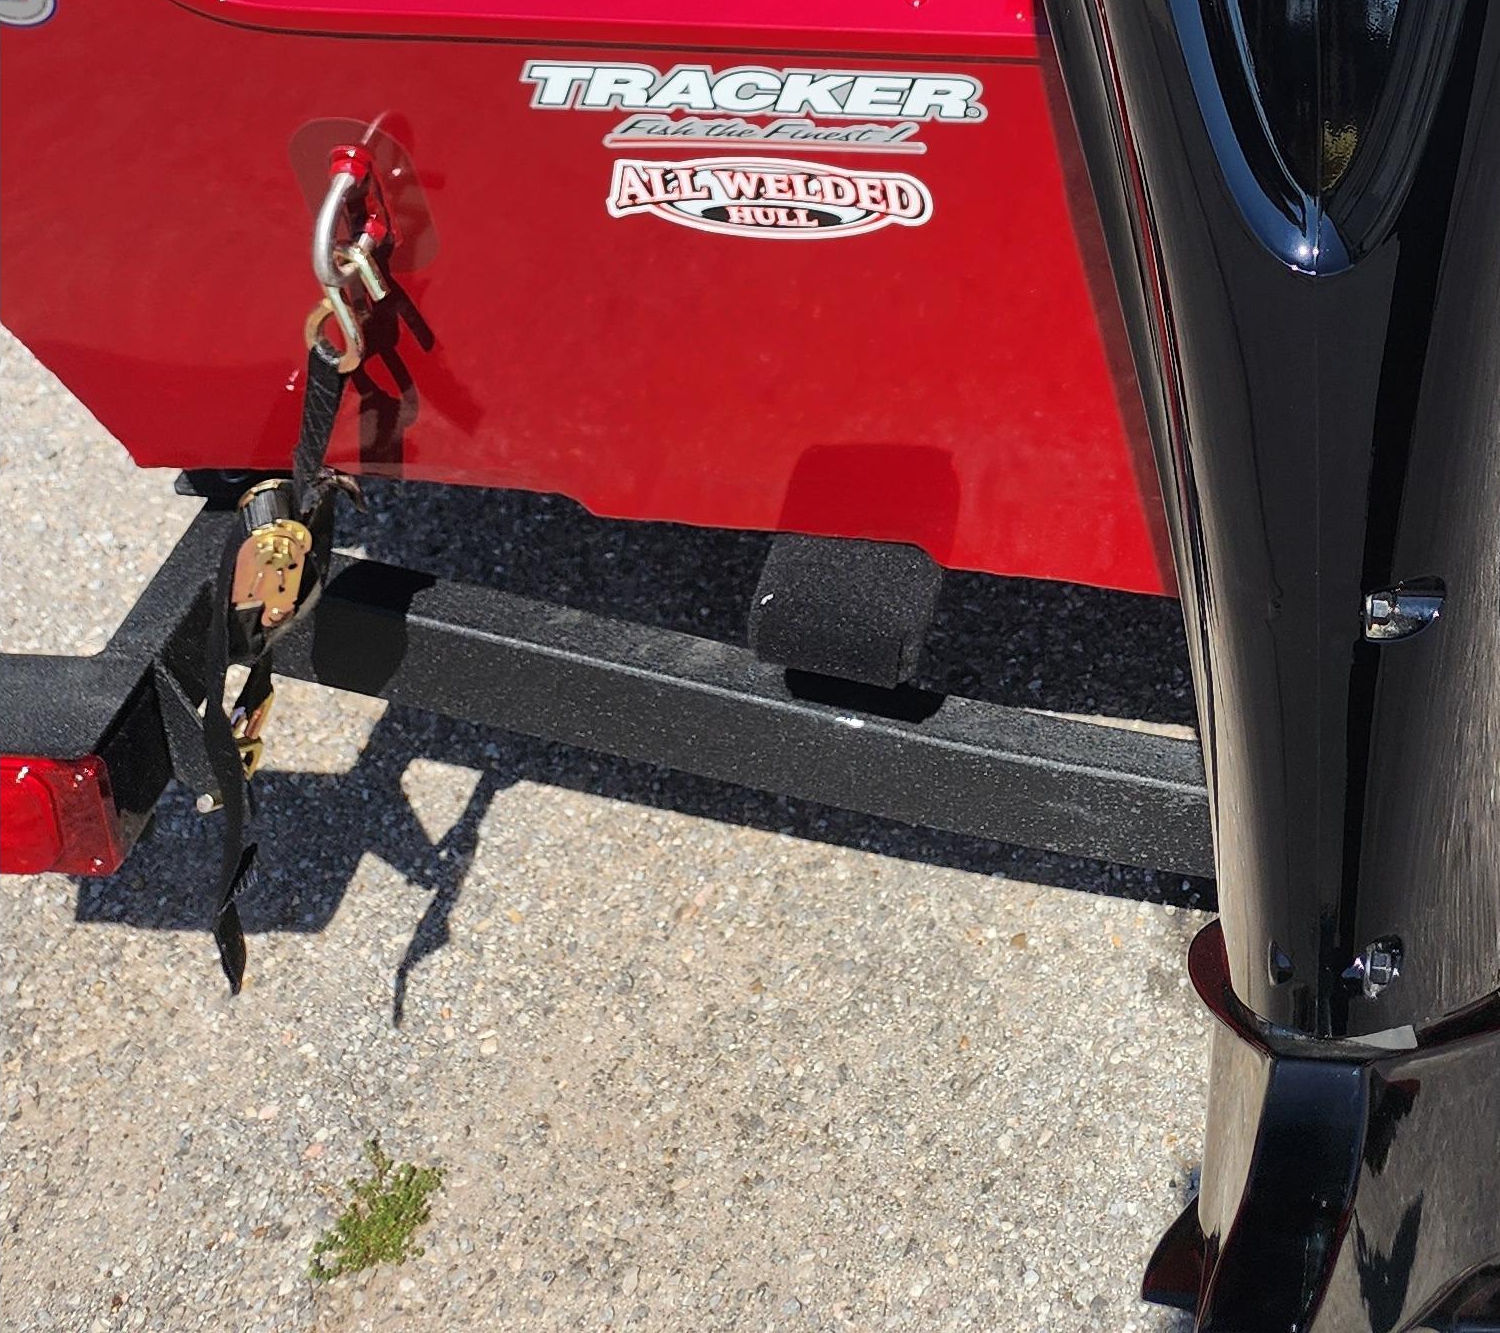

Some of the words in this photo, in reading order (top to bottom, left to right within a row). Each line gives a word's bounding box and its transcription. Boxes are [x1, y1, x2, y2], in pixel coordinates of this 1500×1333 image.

[527, 63, 978, 120] TRACKER
[620, 118, 695, 136] Fish
[700, 120, 747, 138] the
[616, 165, 713, 208] ALL
[711, 168, 923, 219] WELDED
[727, 205, 819, 228] HULL
